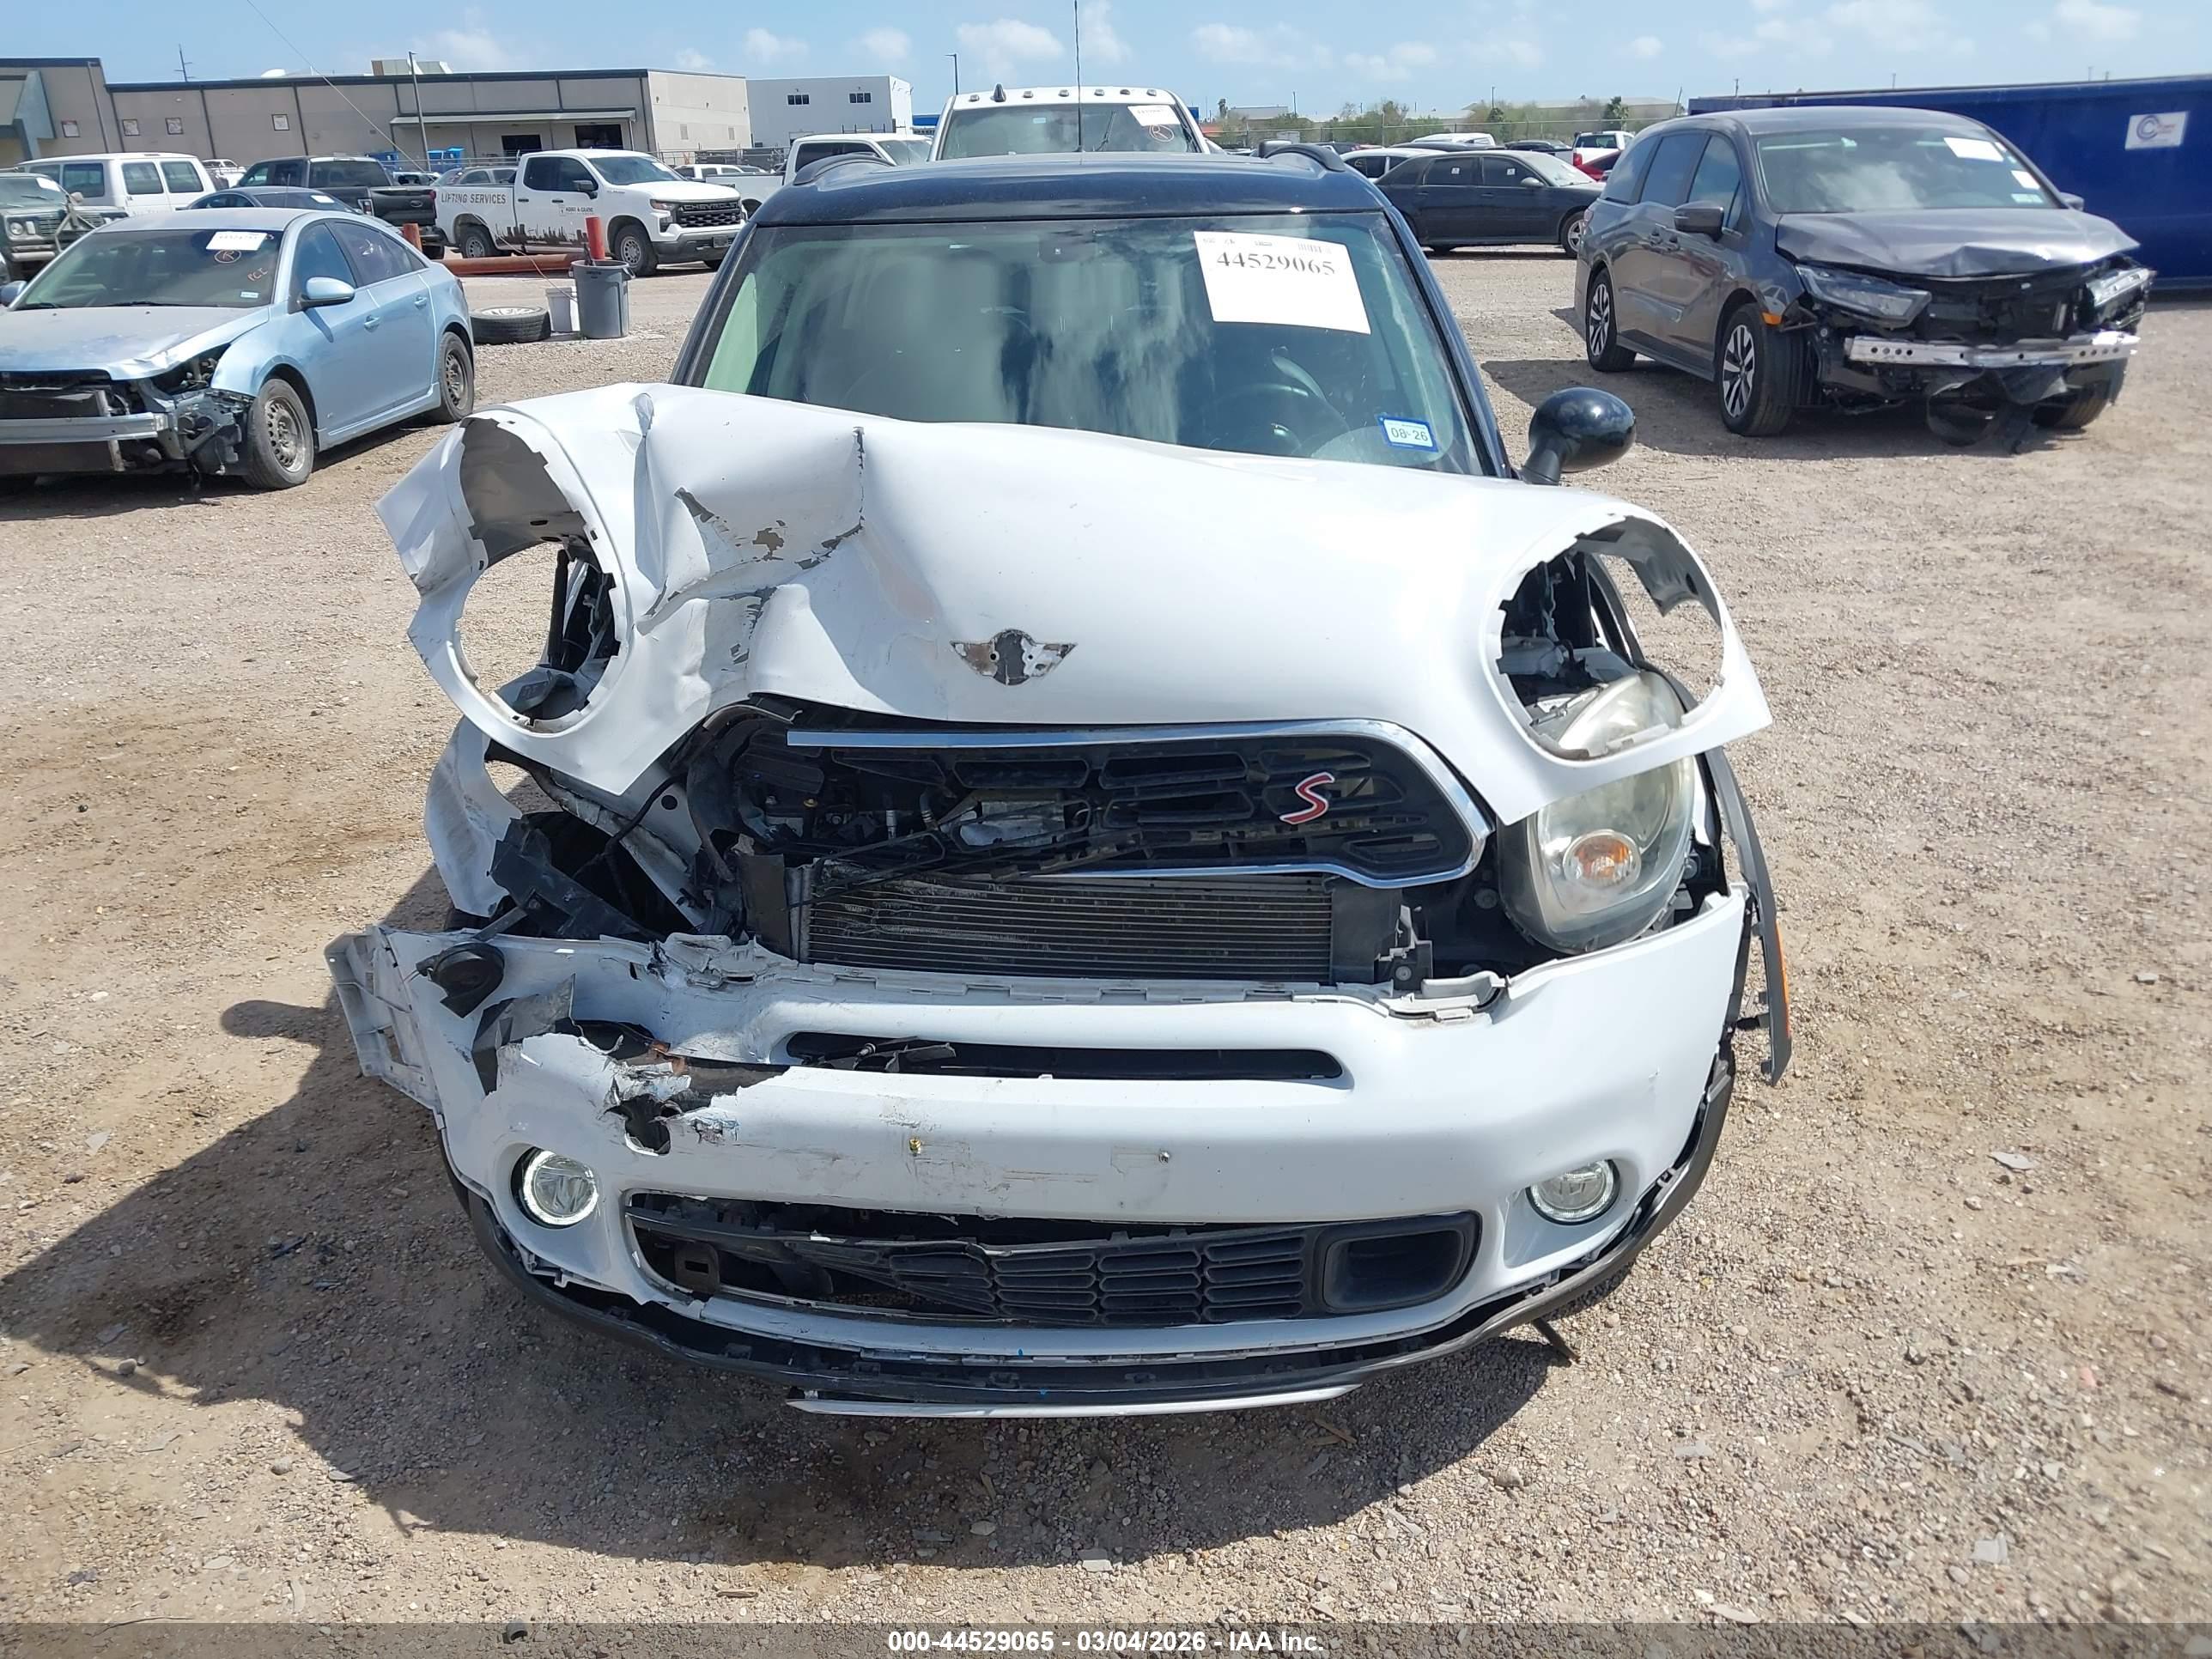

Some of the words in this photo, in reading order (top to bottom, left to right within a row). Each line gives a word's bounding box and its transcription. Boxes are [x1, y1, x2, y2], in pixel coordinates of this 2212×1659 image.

[441, 193, 468, 204] LIFTING
[470, 193, 507, 204] SERVICES
[1216, 251, 1336, 276] 44529065
[1279, 772, 1335, 825] S
